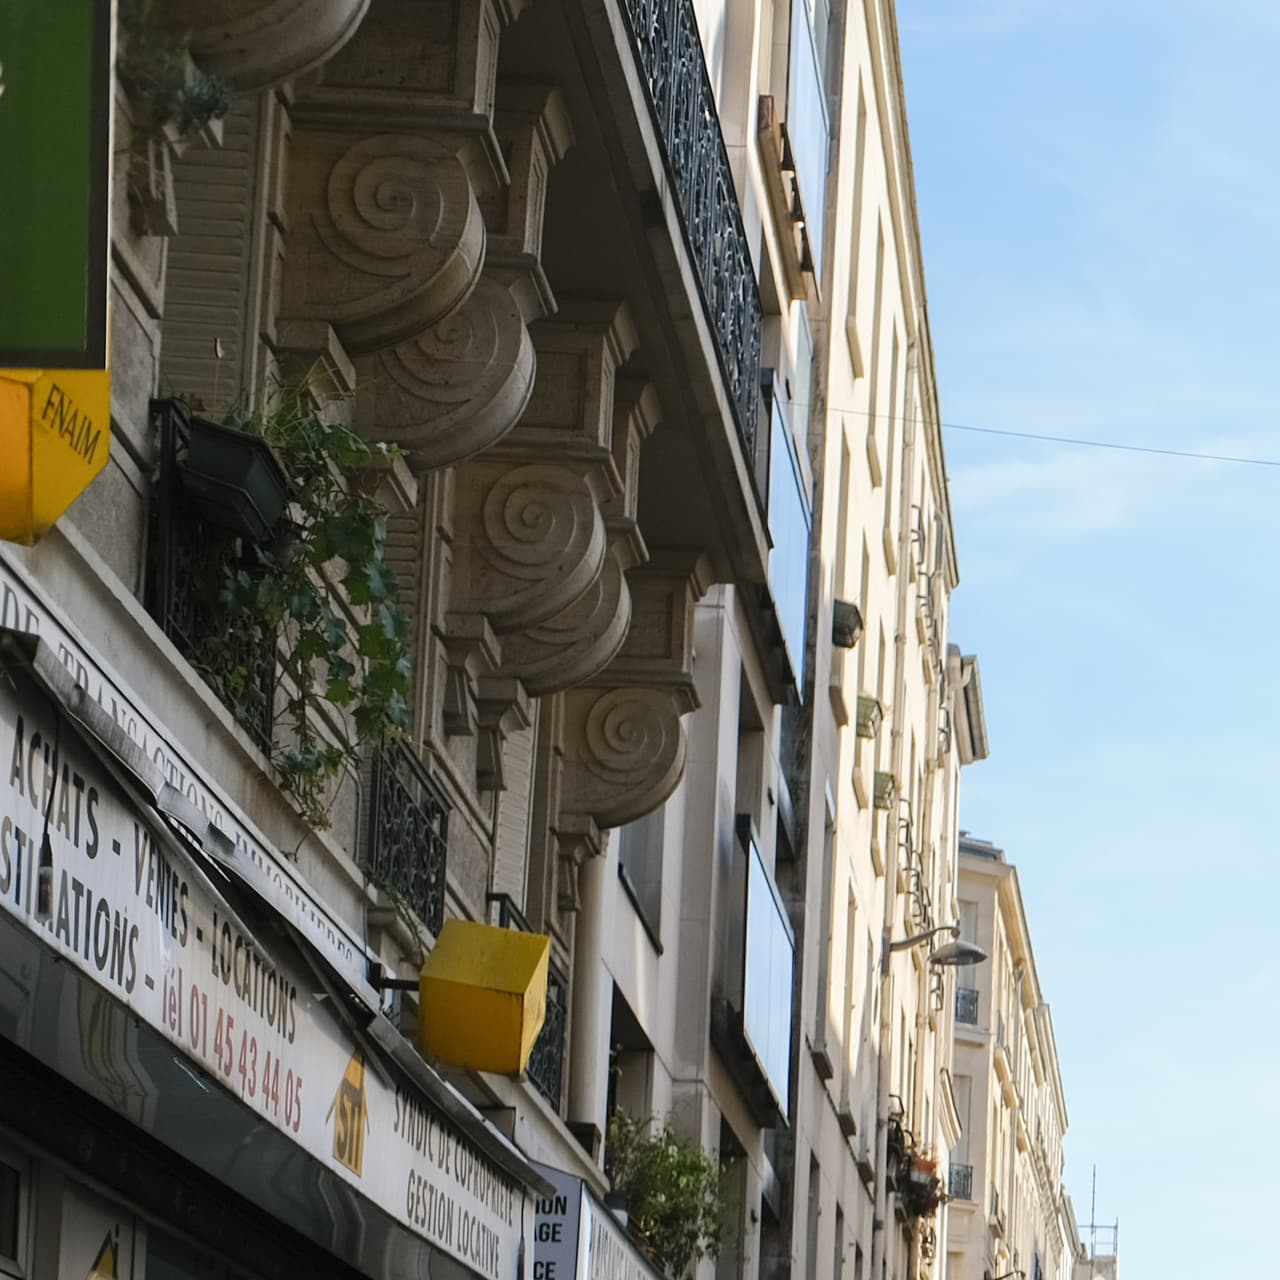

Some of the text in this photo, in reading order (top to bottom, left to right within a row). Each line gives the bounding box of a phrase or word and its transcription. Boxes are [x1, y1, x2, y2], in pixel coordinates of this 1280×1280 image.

[42, 383, 102, 465] FNAIM
[10, 715, 98, 859] ACHATS
[134, 822, 188, 948] VENTES
[212, 911, 297, 1044] LOCATIONS
[190, 984, 208, 1058] 01
[214, 1007, 234, 1077] 45
[239, 1030, 258, 1099] 43
[263, 1051, 280, 1117] 44
[285, 1069, 302, 1133] 05
[394, 1088, 434, 1162] SYNDIC
[439, 1121, 450, 1176] DE
[407, 1169, 500, 1279] GESTION LOCATIVE
